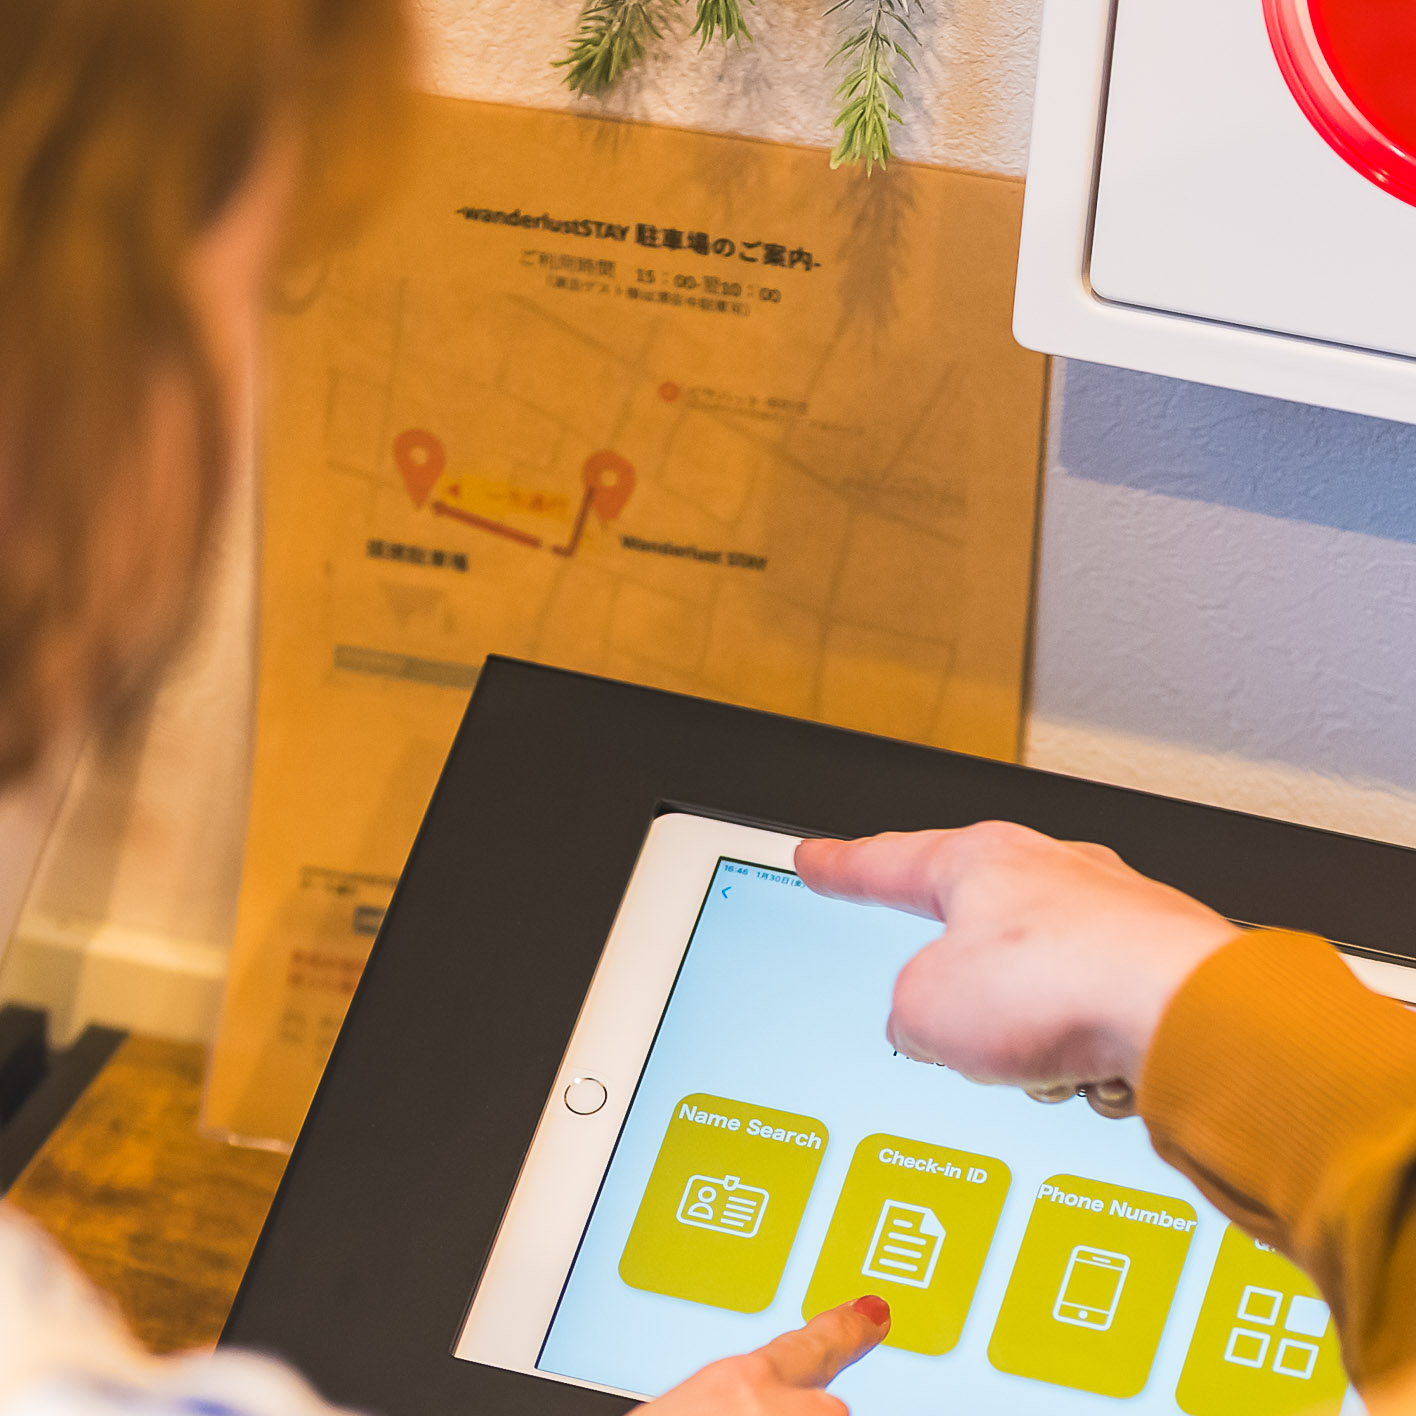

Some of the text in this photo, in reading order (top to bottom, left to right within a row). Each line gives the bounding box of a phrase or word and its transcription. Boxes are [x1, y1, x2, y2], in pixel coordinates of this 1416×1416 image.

[678, 1103, 822, 1150] Name Search
[878, 1147, 988, 1185] Check-in ID
[1037, 1183, 1198, 1233] Phone Number
